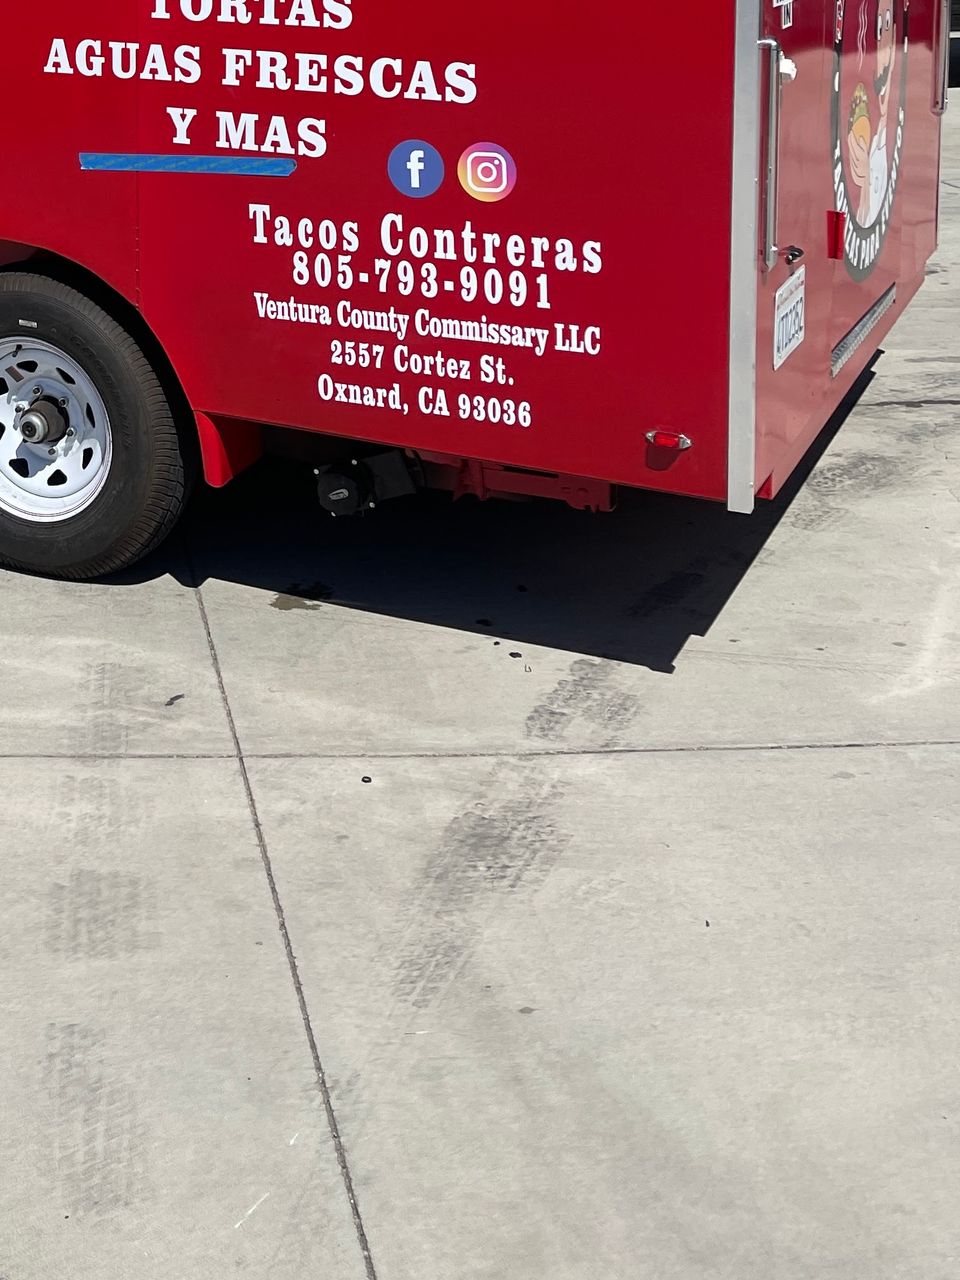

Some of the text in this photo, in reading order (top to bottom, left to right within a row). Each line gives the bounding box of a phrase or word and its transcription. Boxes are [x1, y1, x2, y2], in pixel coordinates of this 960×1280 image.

[43, 38, 477, 104] AGUAS FRESCAS
[166, 107, 327, 158] Y MAS
[248, 203, 602, 274] Tacos Contreras
[292, 251, 551, 309] 805-793-9091
[253, 292, 601, 356] Ventura County Commissary LLC
[330, 340, 515, 385] 2557 Cortez St.
[317, 373, 532, 428] Oxnard, CA 93036
